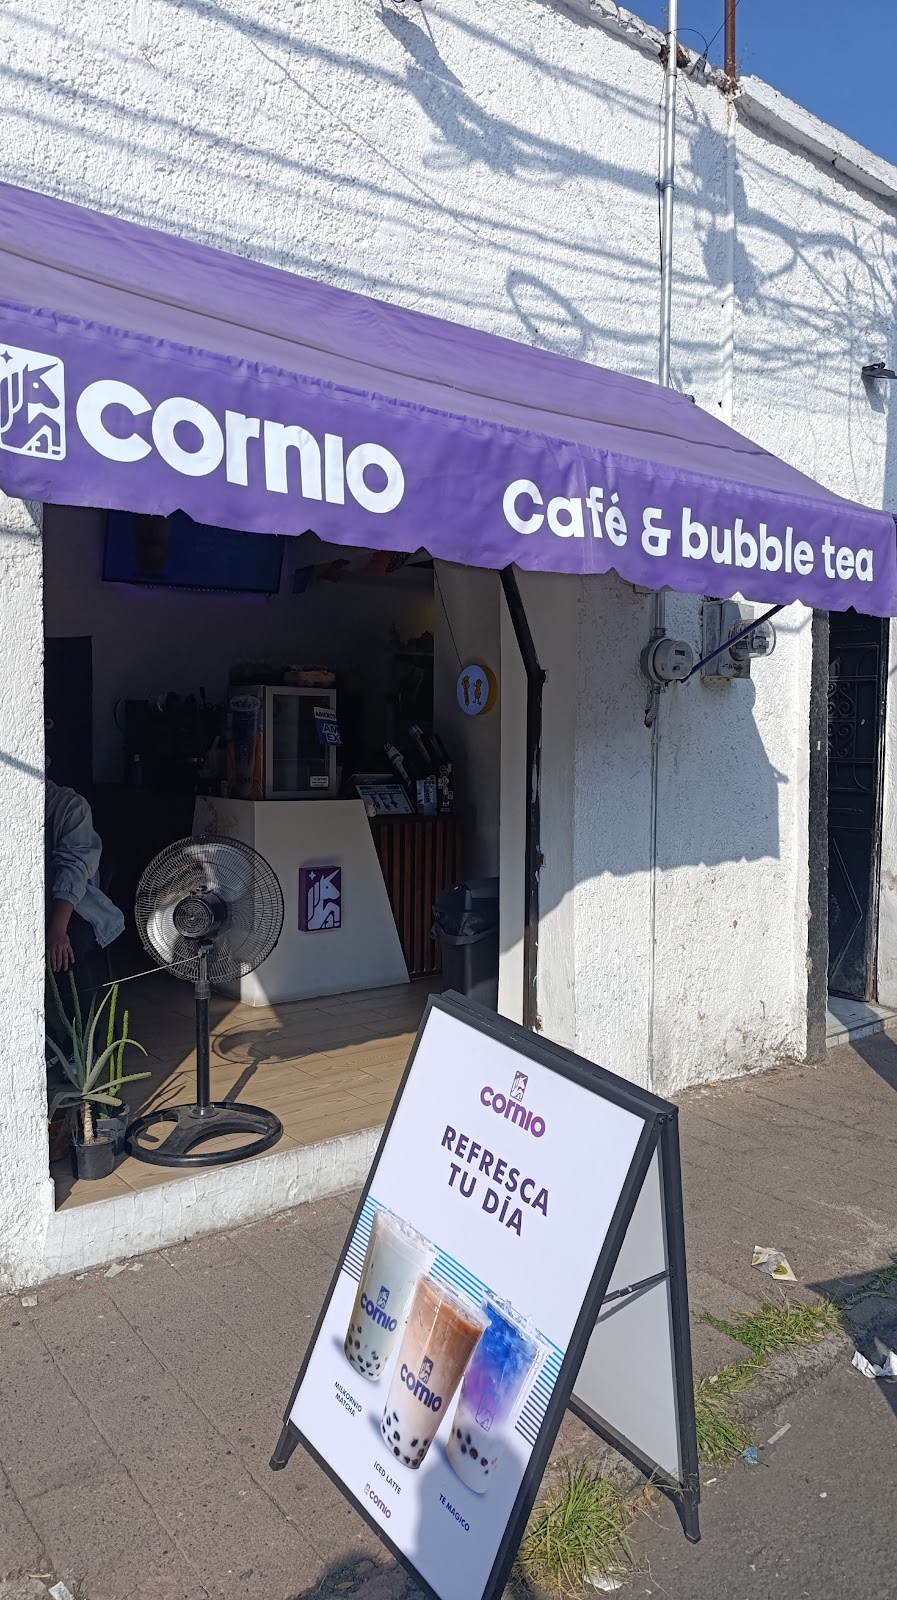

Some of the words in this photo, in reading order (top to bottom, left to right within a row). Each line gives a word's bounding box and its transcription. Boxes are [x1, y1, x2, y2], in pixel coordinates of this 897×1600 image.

[76, 379, 405, 514] cornio
[503, 479, 627, 547] Café
[642, 507, 671, 557] &
[681, 507, 814, 575] bubble
[821, 536, 874, 582] tea
[480, 1086, 546, 1138] cornio
[441, 1124, 549, 1217] REFRESCA
[448, 1162, 477, 1198] TU
[481, 1187, 523, 1237] DÍA
[360, 1292, 397, 1332] cornio
[334, 1381, 362, 1412] MILKORNIO
[335, 1393, 356, 1417] MATCHA
[400, 1363, 442, 1413] cornio
[373, 1461, 386, 1477] ICED
[385, 1474, 402, 1495] LATTE
[369, 1490, 392, 1519] cornio
[445, 1502, 470, 1532] MÁGICO
